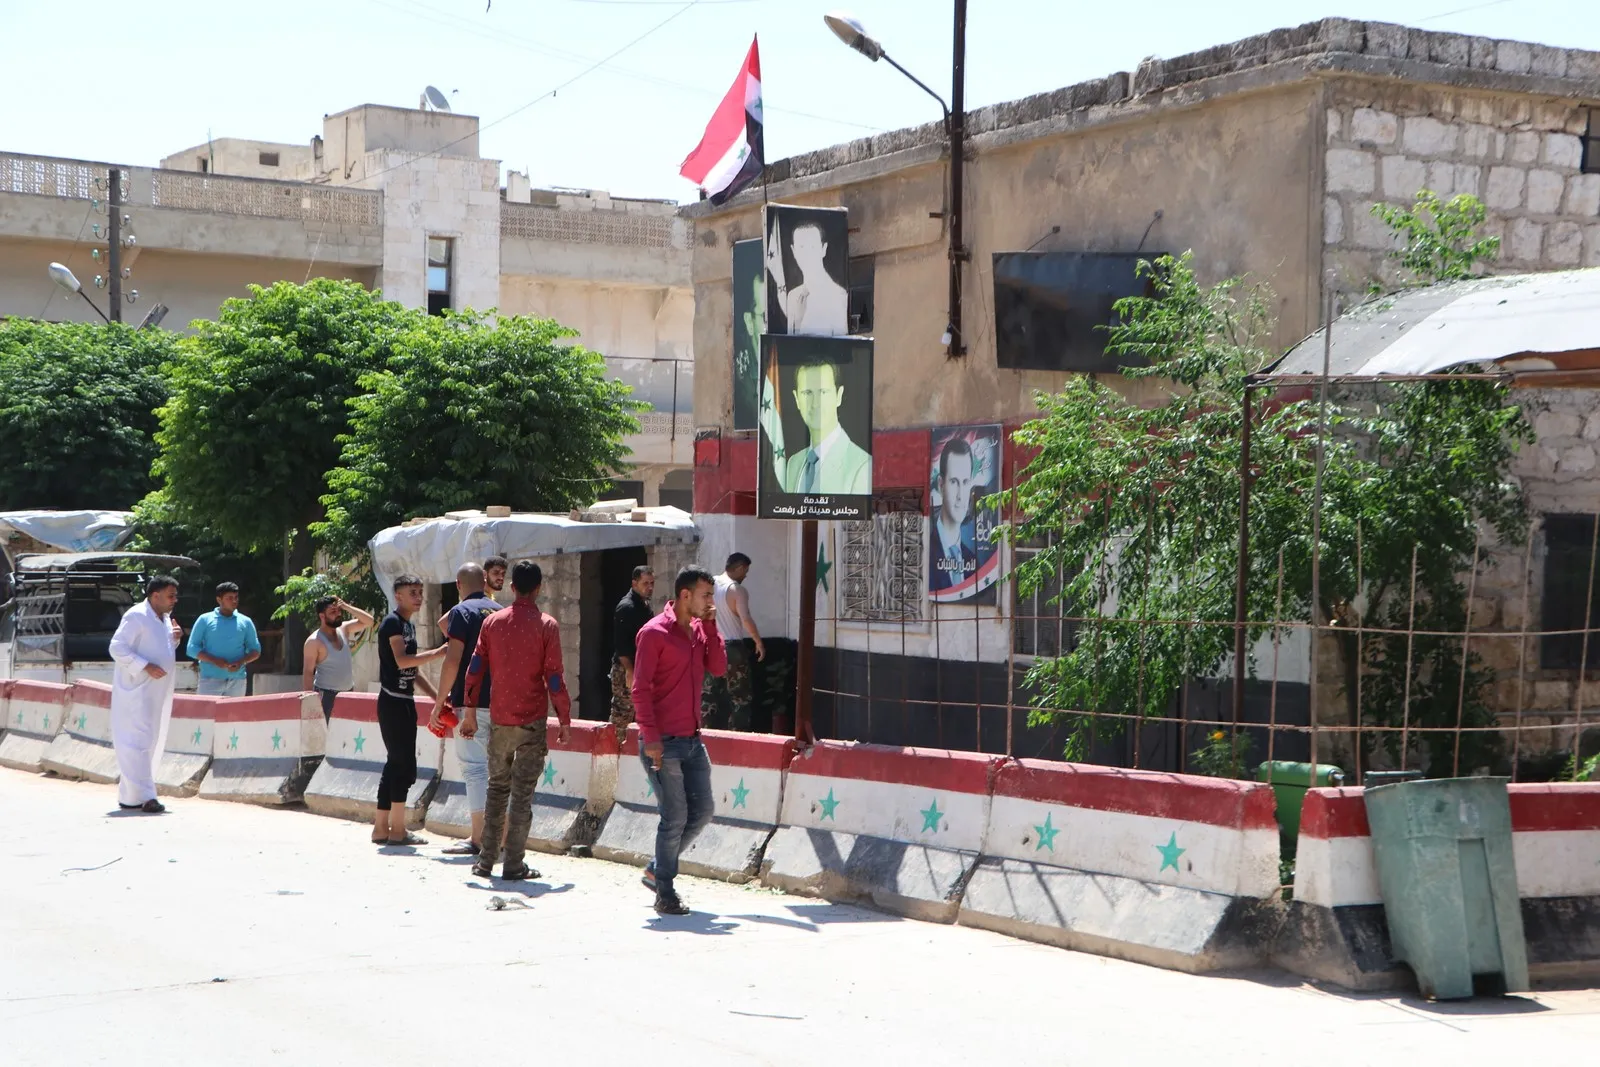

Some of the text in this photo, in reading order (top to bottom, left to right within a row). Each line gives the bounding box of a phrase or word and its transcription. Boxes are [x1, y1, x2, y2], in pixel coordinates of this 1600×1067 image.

[803, 496, 829, 505] تقدمة
[772, 505, 859, 516] مجلس مدينة تل رفعت
[959, 557, 978, 573] لأمل
